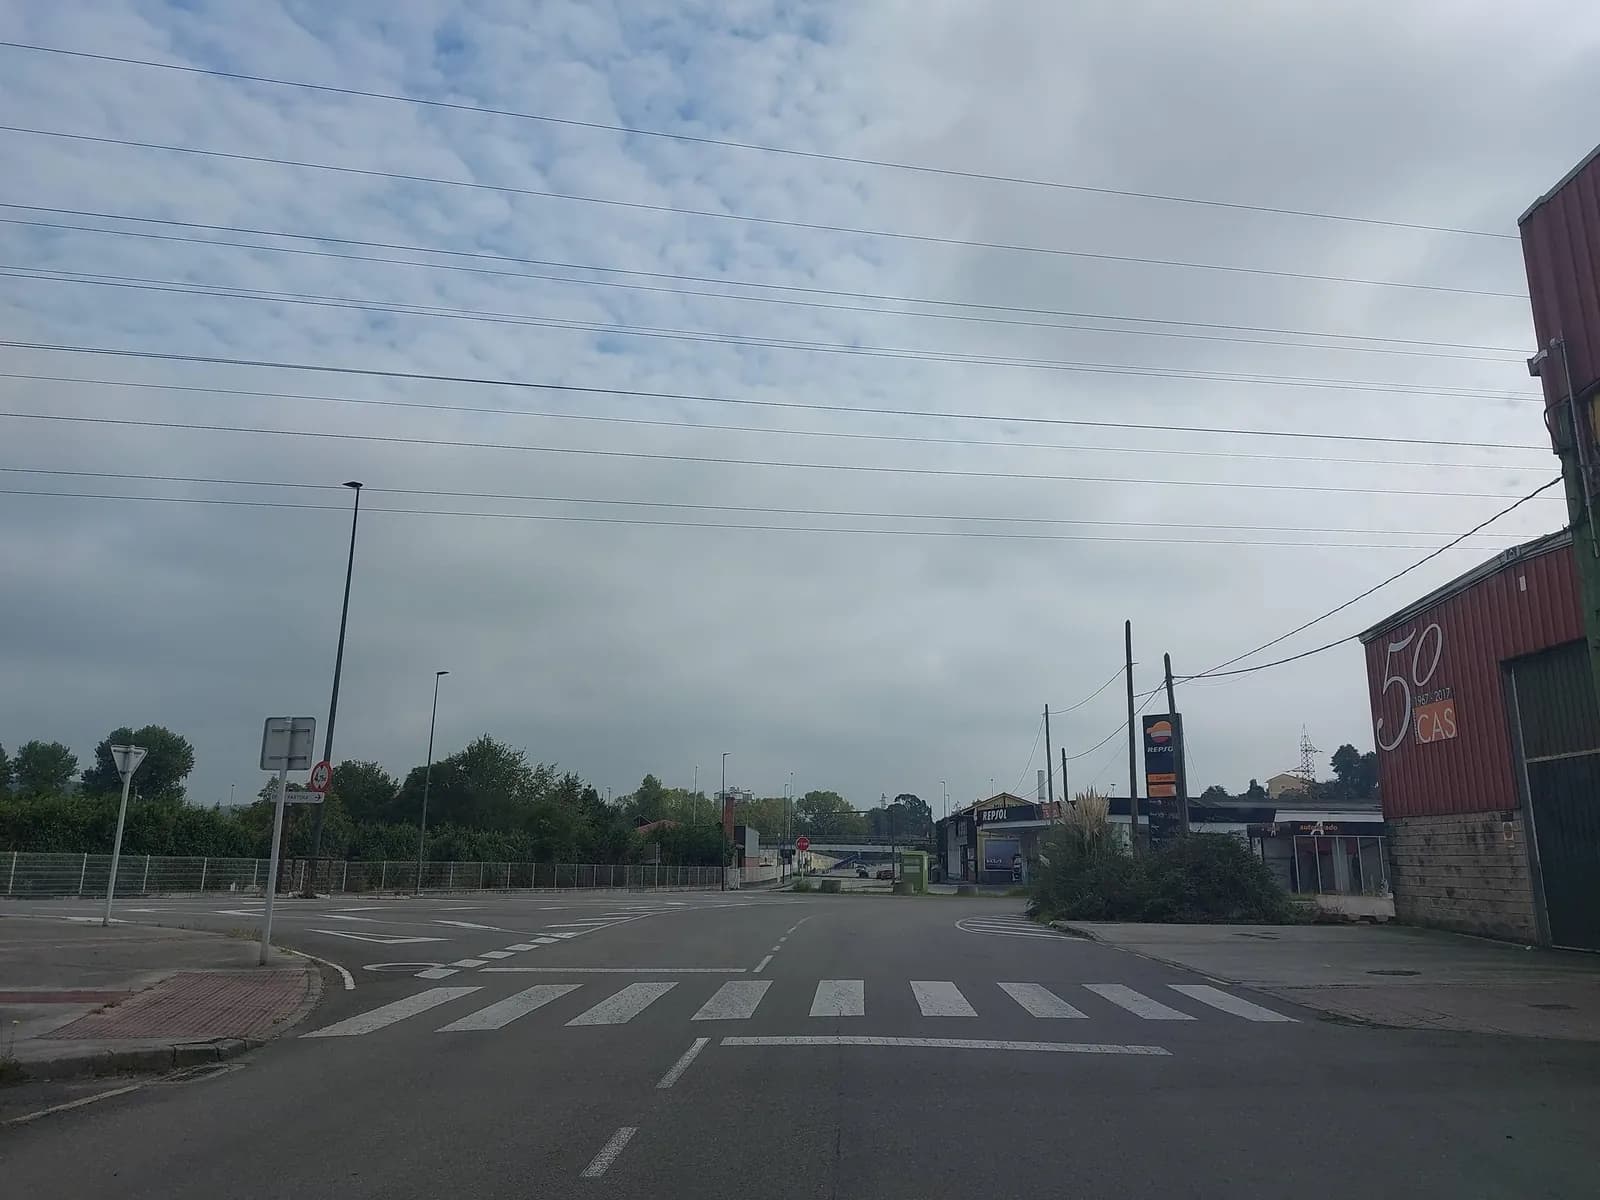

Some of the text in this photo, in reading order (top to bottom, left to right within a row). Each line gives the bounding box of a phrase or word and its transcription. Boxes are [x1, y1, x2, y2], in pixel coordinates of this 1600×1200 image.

[1376, 623, 1442, 751] 50
[1434, 687, 1450, 702] 2017
[1417, 708, 1456, 743] CAS
[982, 809, 1007, 821] REPSOL
